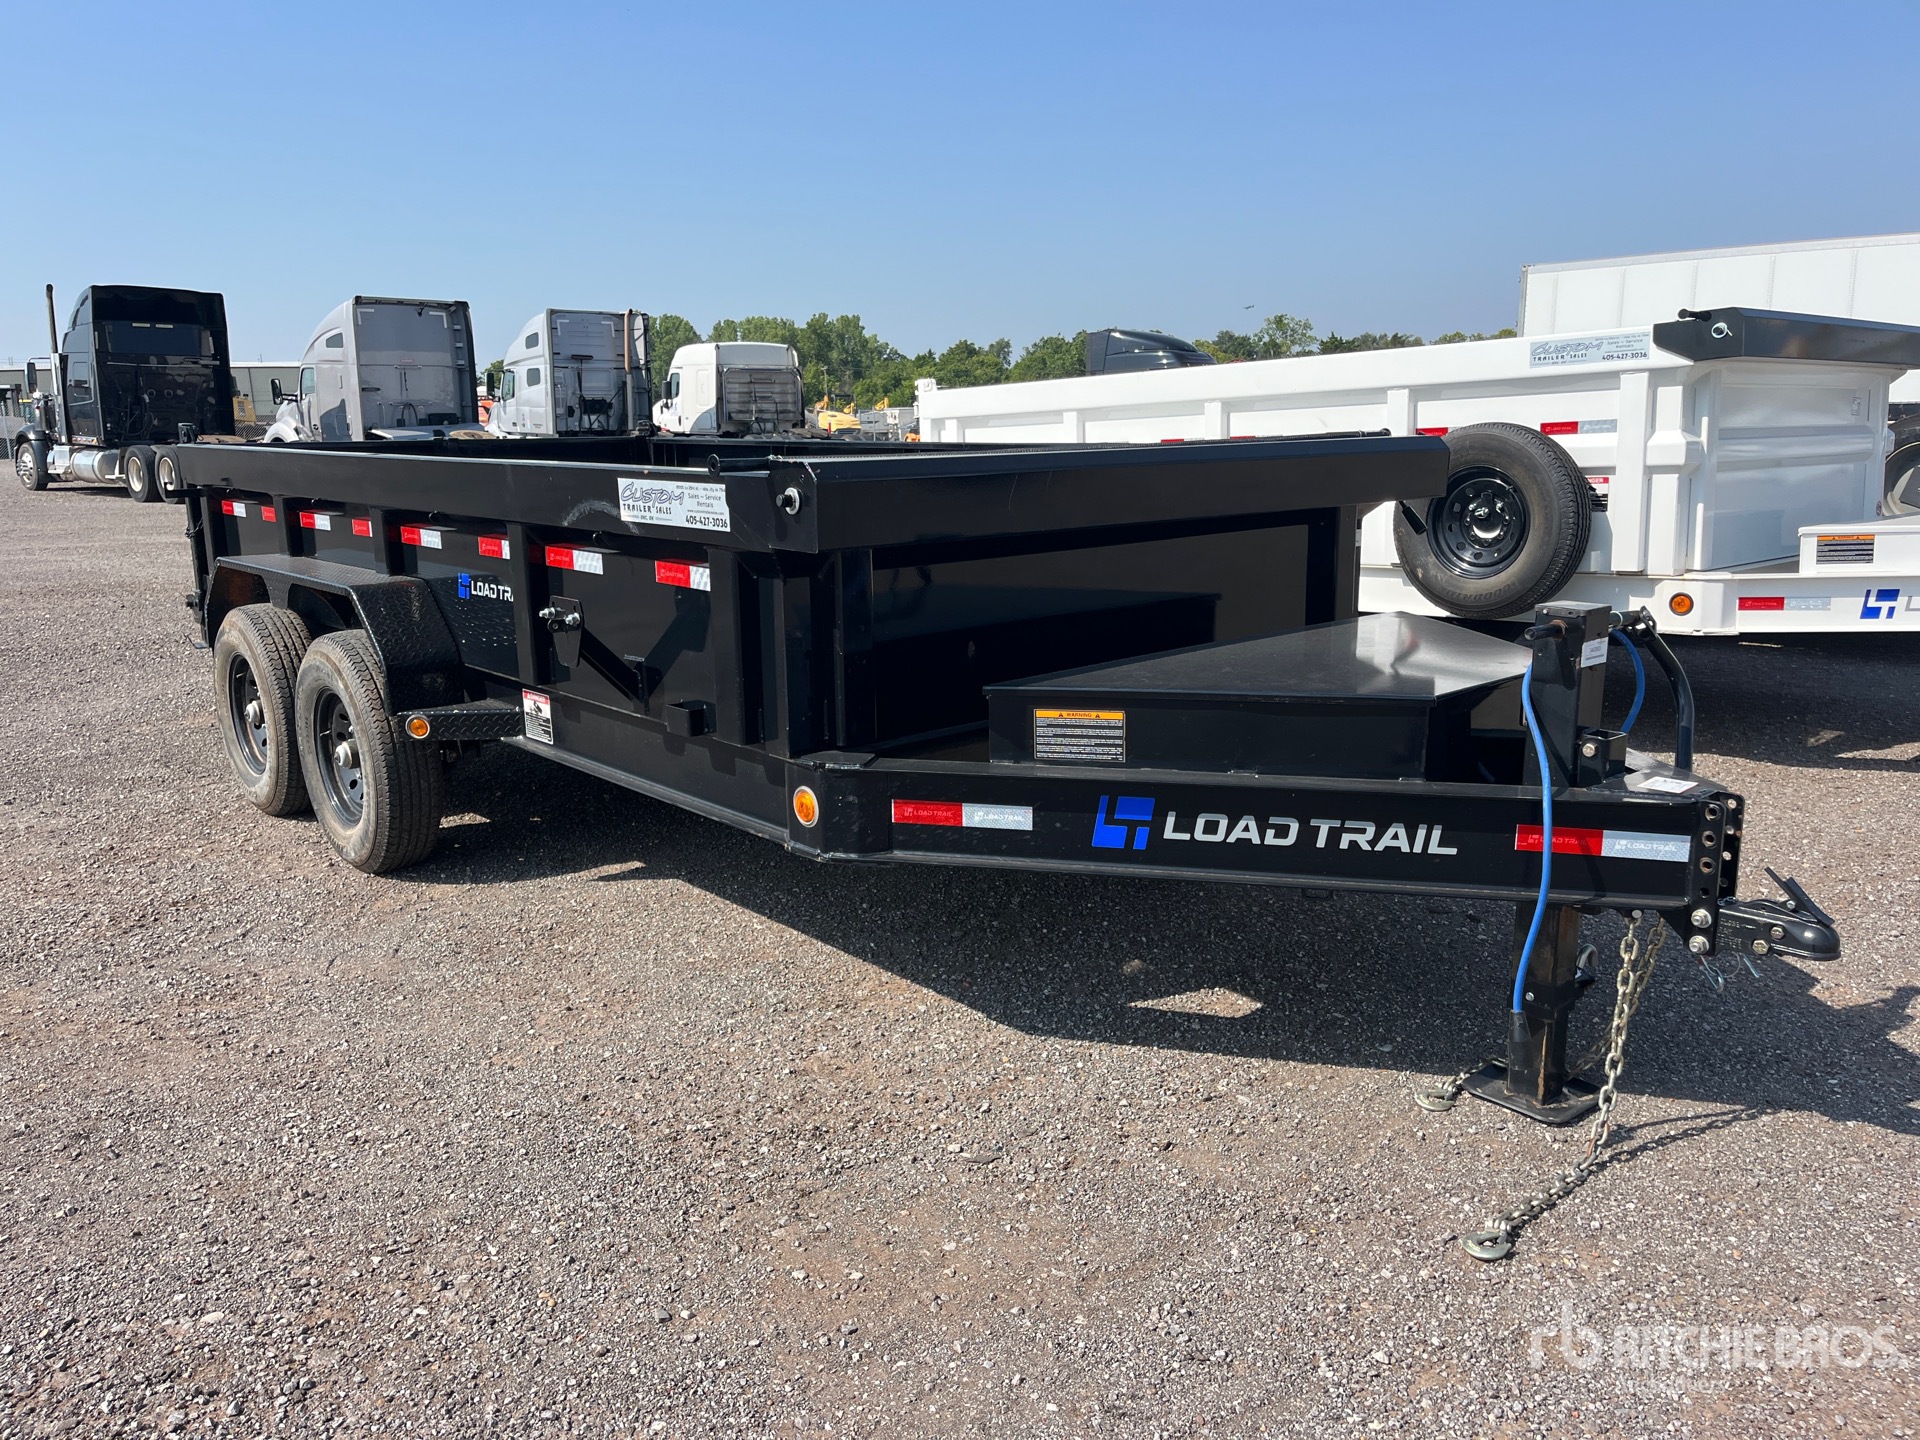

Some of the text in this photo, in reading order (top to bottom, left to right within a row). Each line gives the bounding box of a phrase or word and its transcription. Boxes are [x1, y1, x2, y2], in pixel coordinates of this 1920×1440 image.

[1532, 341, 1604, 356] CUSTOM
[1533, 354, 1565, 362] TRAILER
[1601, 351, 1648, 361] 405-427-3036
[620, 481, 685, 508] CUSTOM
[622, 503, 672, 515] TRAILER SALES
[696, 500, 714, 508] Rentals
[685, 514, 729, 529] 405-427-3036
[470, 580, 497, 599] LOAD
[1163, 811, 1458, 855] LOAD TRAIL
[1627, 842, 1677, 851] LOAD TRAIL
